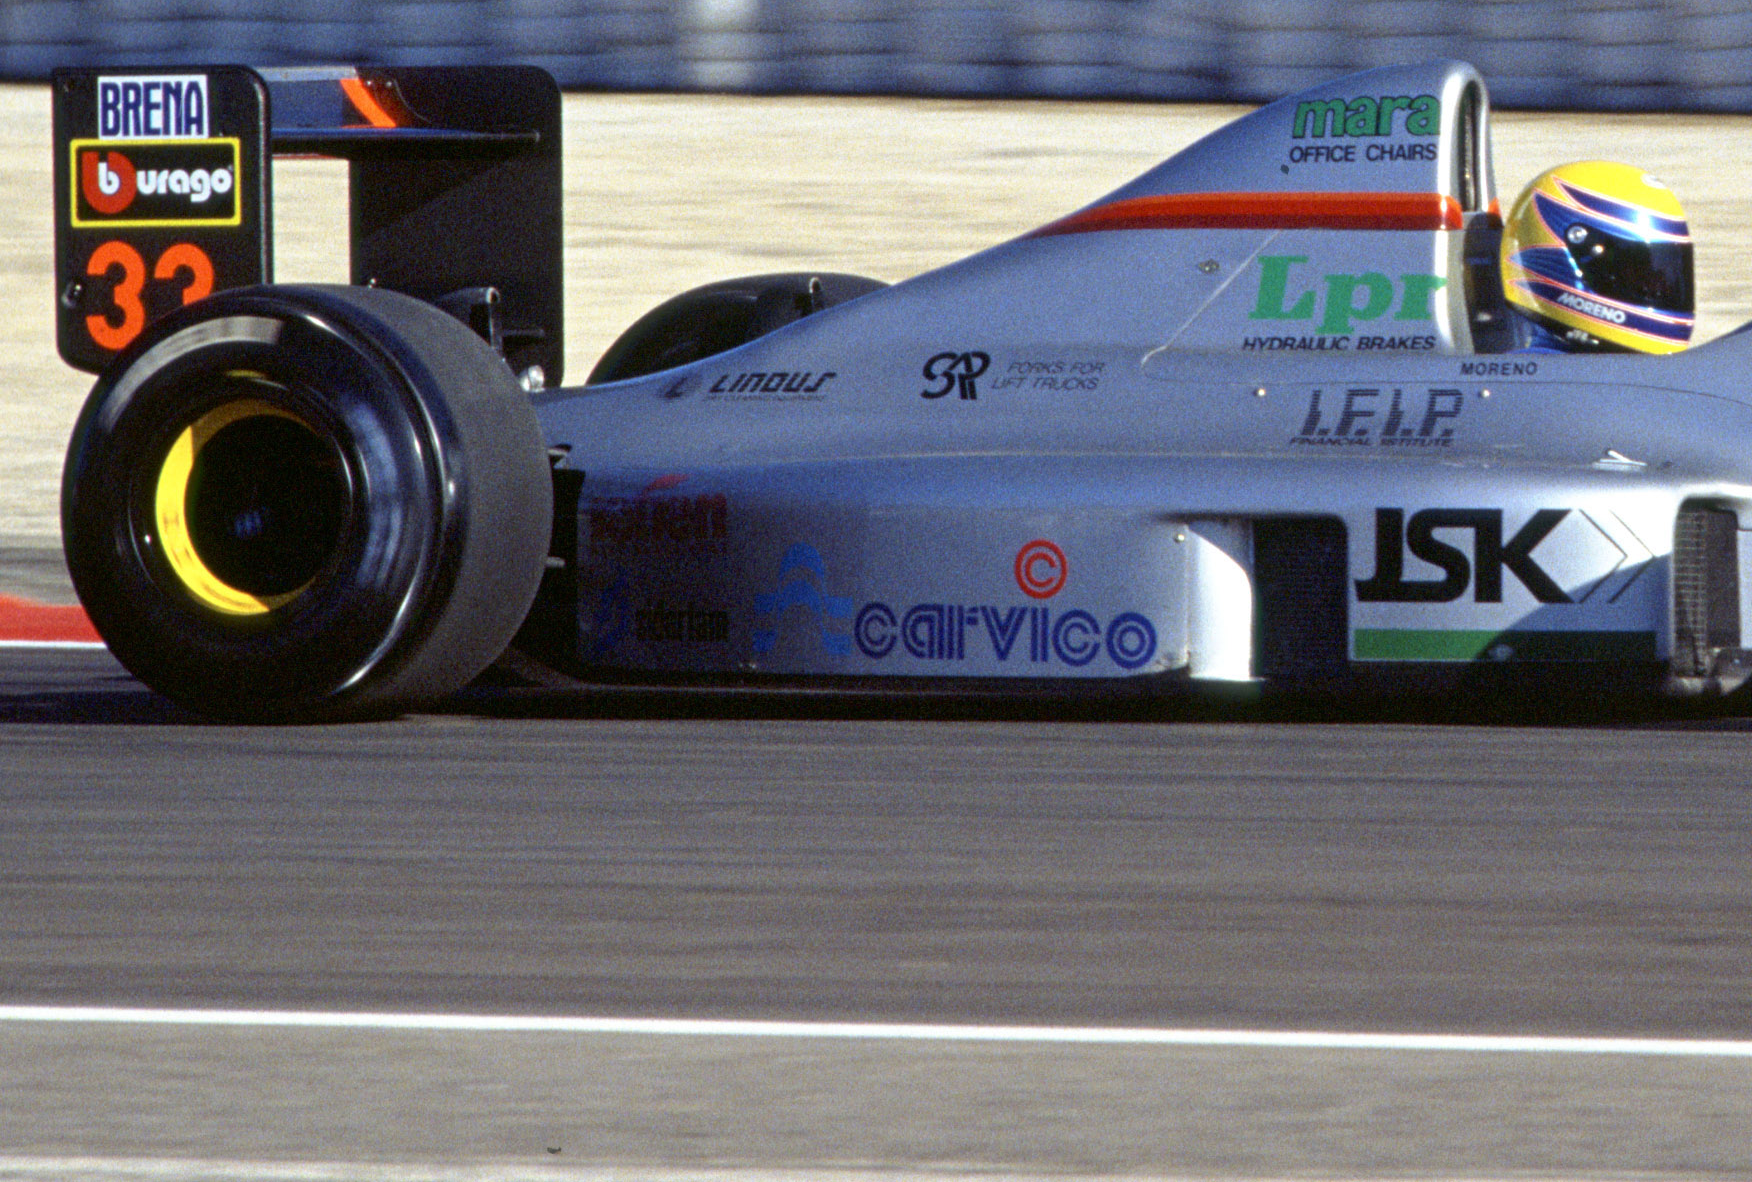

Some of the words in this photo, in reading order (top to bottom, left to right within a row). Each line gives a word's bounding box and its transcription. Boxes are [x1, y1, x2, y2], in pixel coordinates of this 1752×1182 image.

[101, 82, 203, 136] BRENA
[1292, 95, 1440, 139] mara
[1290, 146, 1356, 163] OFFICE
[1366, 144, 1437, 161] CHAIRS
[1248, 255, 1447, 334] Lpr
[1557, 292, 1627, 324] MORENO
[1243, 337, 1349, 350] HYDRAULIC
[1356, 336, 1436, 350] BRAKES
[1007, 360, 1065, 374] FORKS
[1069, 360, 1106, 375] FOR
[1460, 362, 1538, 377] MORENO
[991, 376, 1029, 391] LIFT
[1033, 376, 1099, 391] TRUCKS
[1290, 437, 1371, 447] FINANCIAL
[1355, 508, 1573, 603] JSK
[854, 602, 1157, 667] carvico
